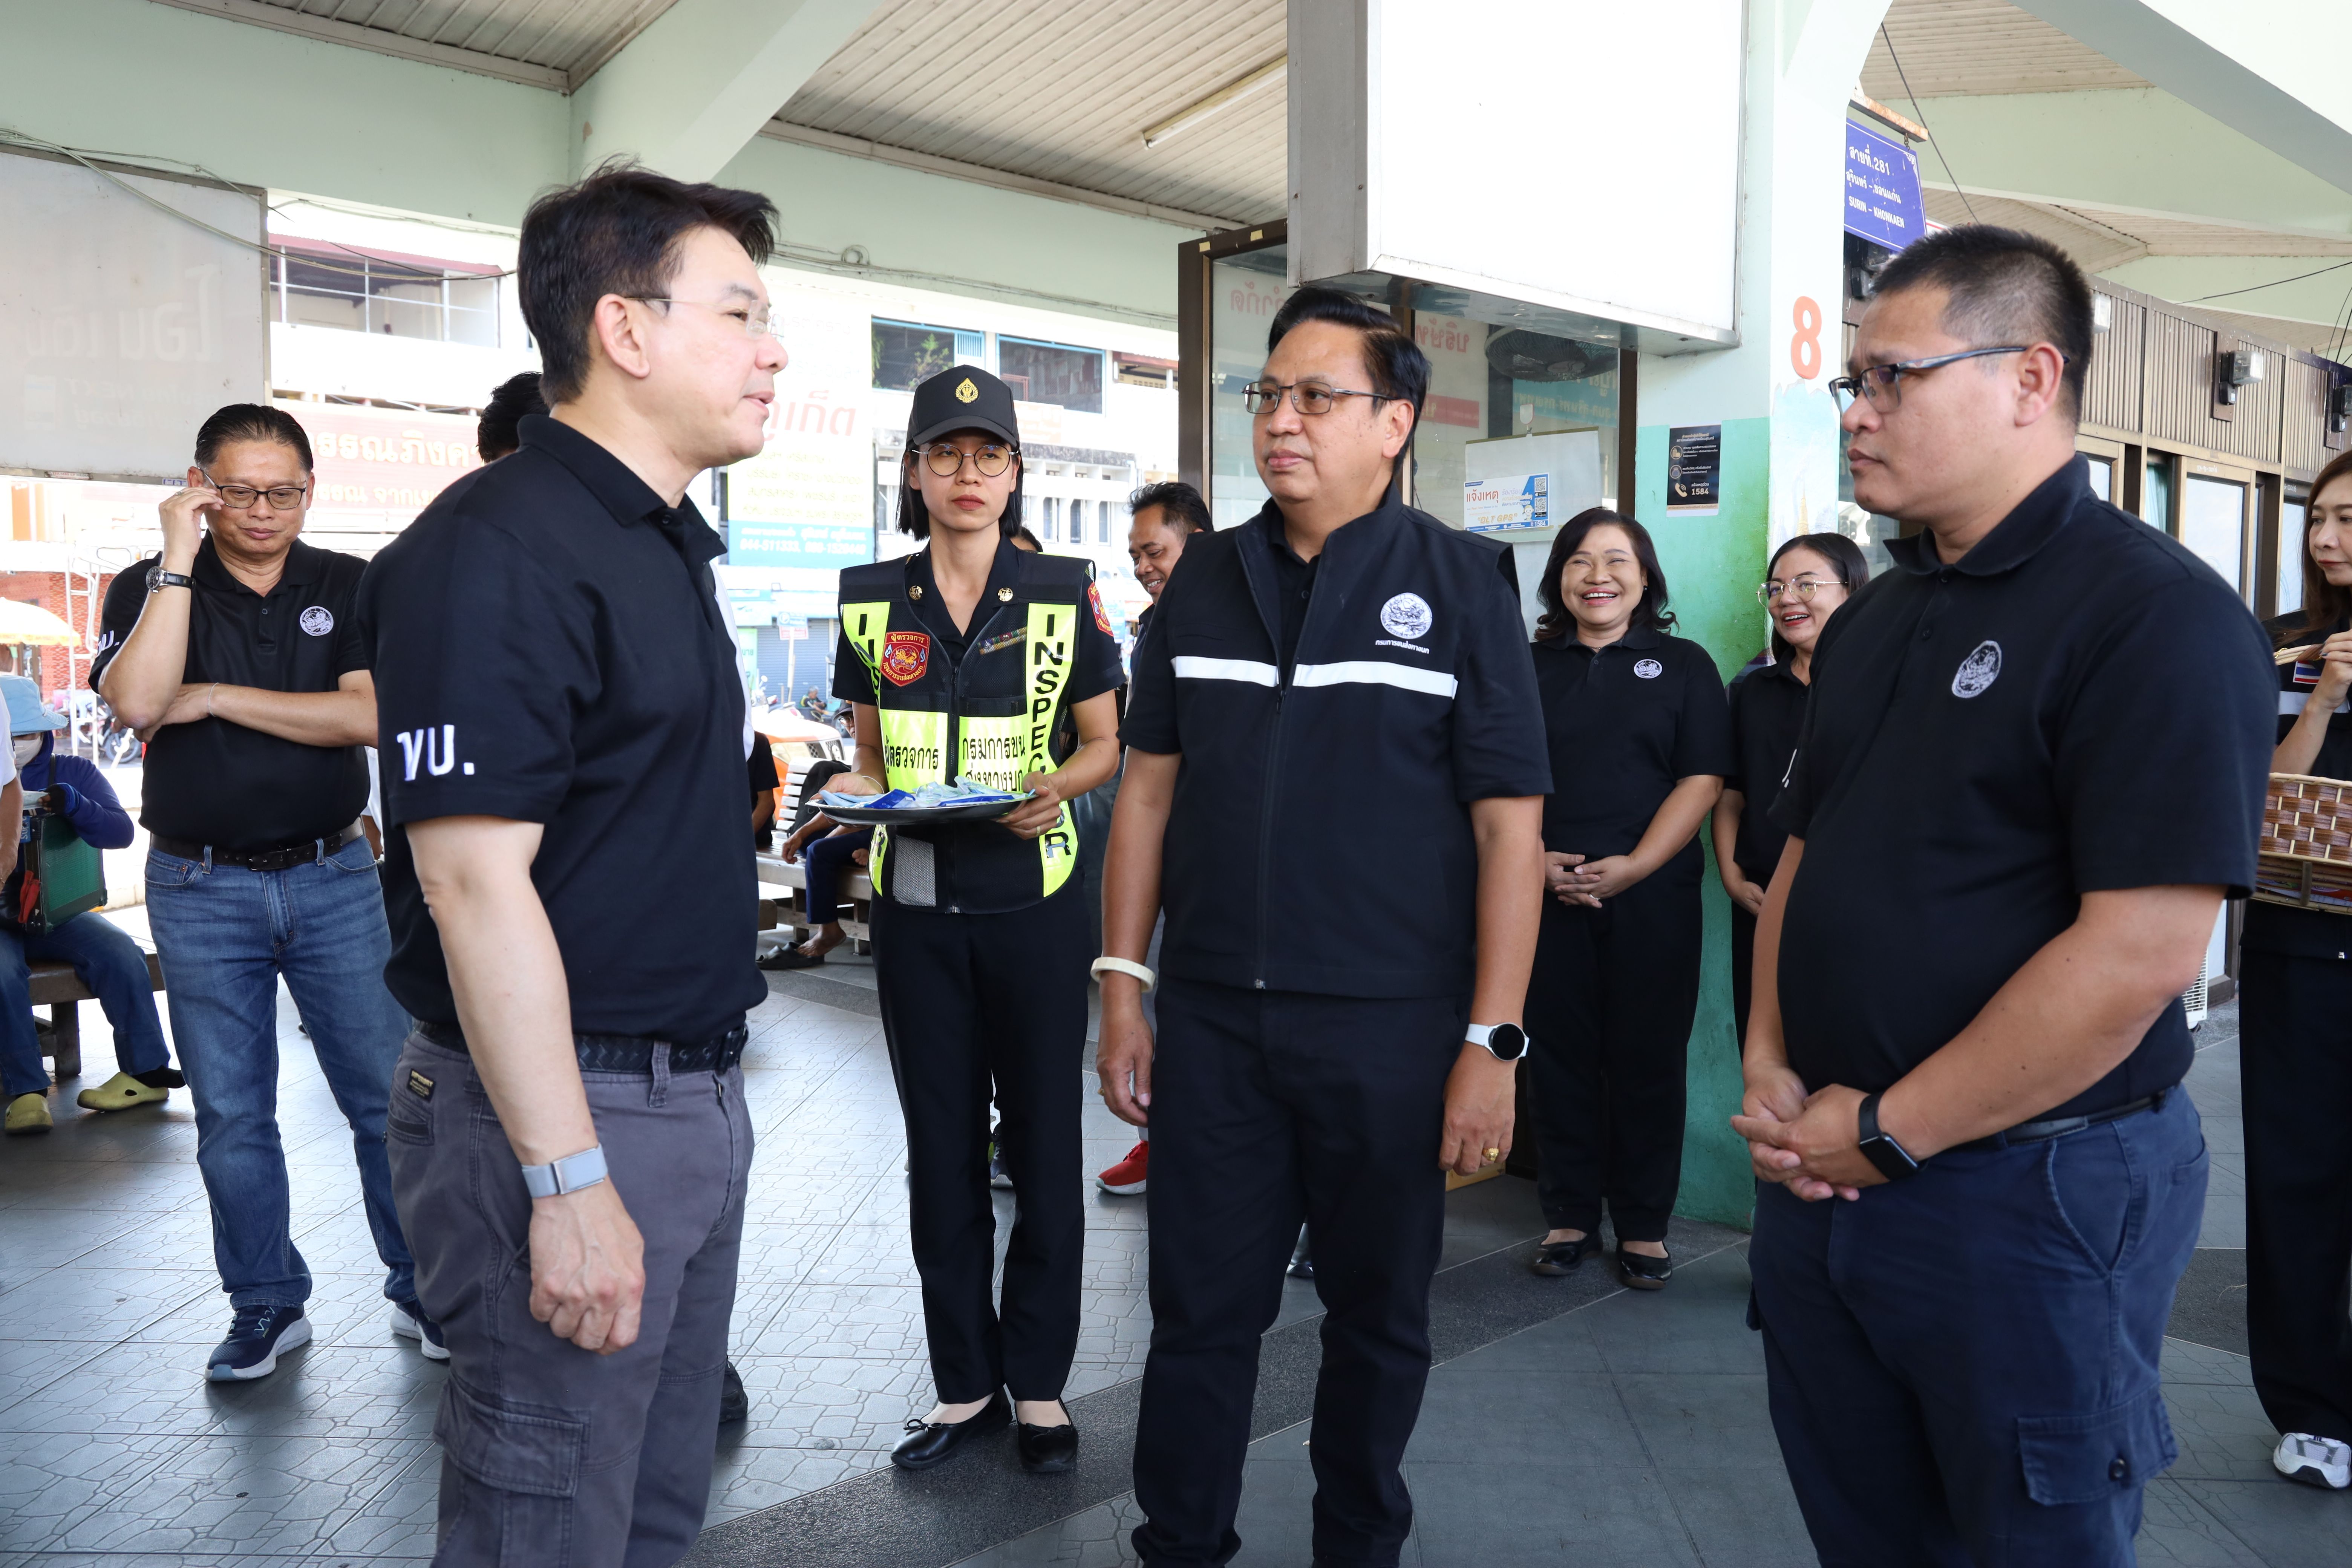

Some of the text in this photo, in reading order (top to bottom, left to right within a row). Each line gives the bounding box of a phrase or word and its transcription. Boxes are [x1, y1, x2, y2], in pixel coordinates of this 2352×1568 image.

[1874, 185, 1902, 204] ขอนแก่น
[1849, 196, 1867, 213] SURIN
[1874, 206, 1905, 228] KHONKAEN
[1791, 296, 1822, 380] 8
[1466, 489, 1499, 503] แจ้งเหตุ
[890, 633, 925, 643] ผู้ตรวจการ
[1375, 640, 1430, 654] กรมการขนส่งทางบก
[882, 662, 924, 681] กรมการขนส่งทางบก
[962, 734, 1026, 760] กรมการขน
[1028, 614, 1072, 858] INSPECR
[884, 735, 940, 775] ผู้ตรวจการ
